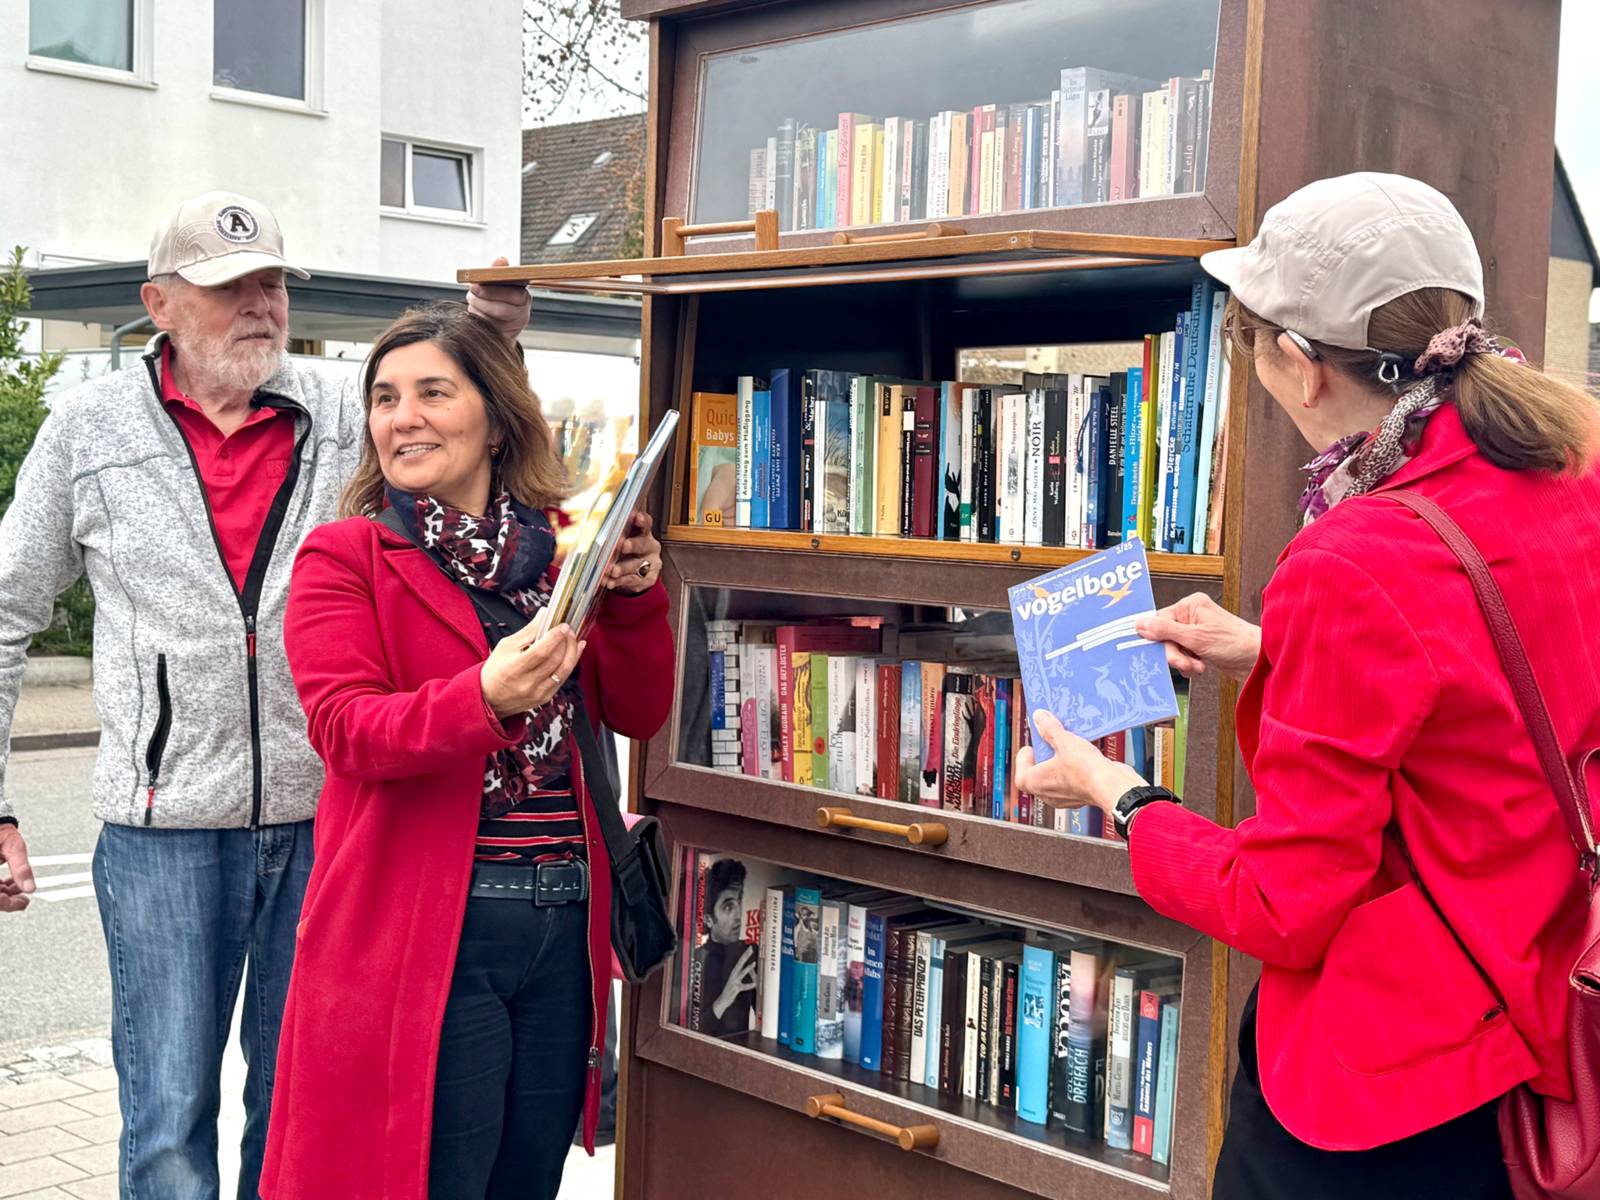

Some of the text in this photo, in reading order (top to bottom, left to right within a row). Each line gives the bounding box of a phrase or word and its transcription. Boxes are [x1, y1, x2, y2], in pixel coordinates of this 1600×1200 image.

[1183, 144, 1194, 174] Leila
[230, 213, 249, 232] A
[1181, 281, 1203, 454] Schatztruhe Deutschland
[705, 428, 735, 444] Babys
[743, 400, 752, 441] Müßiggang
[1031, 420, 1041, 457] NOIR
[1108, 404, 1119, 466] DANIELLE STEEL
[1166, 436, 1176, 474] Diercke
[742, 460, 750, 496] Anleitung
[1016, 560, 1143, 621] vogelbote
[781, 736, 789, 761] ASHLEY
[951, 746, 959, 759] Die
[945, 764, 954, 805] MICHAEL
[953, 760, 963, 811] MARSHALL
[913, 1020, 924, 1038] DAS
[1073, 1047, 1089, 1104] DREIFACH
